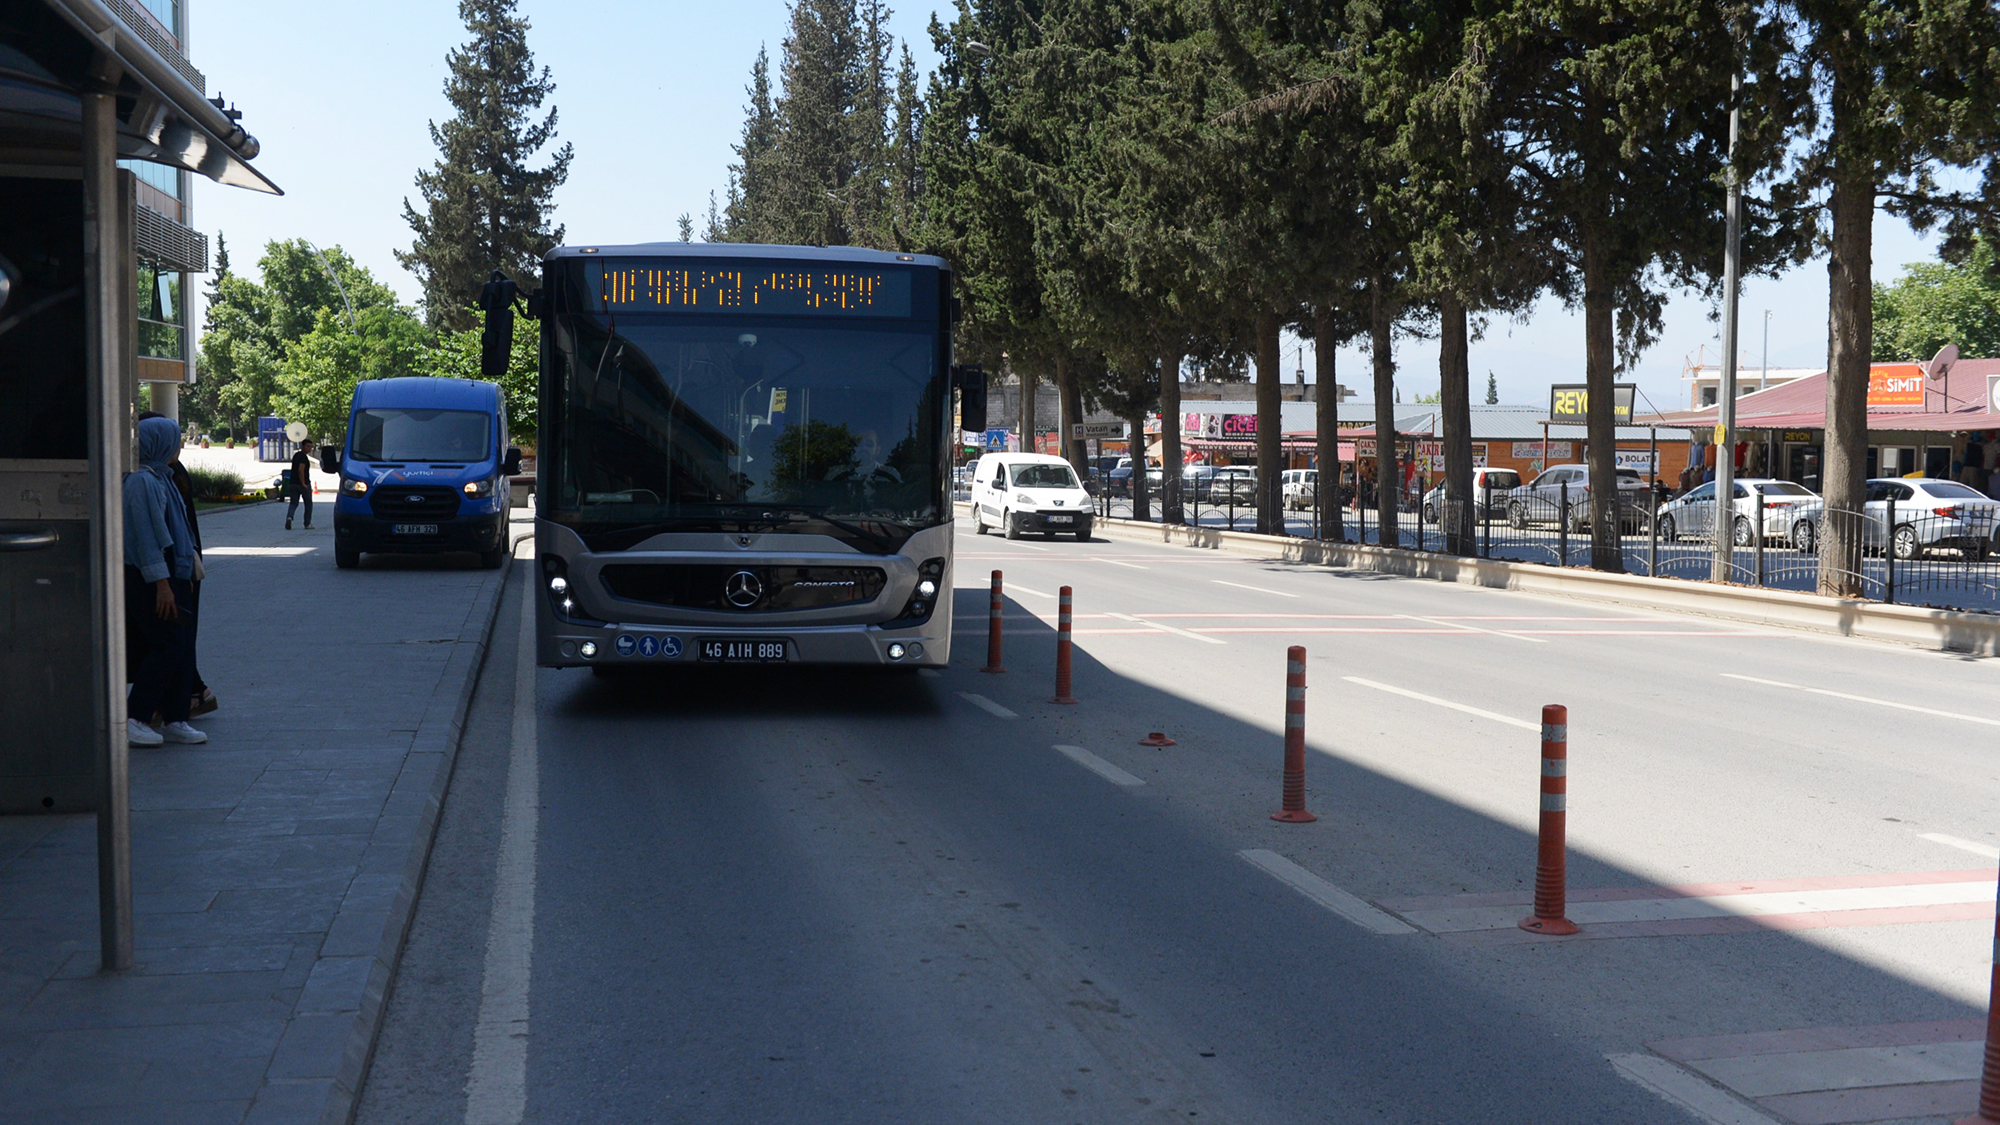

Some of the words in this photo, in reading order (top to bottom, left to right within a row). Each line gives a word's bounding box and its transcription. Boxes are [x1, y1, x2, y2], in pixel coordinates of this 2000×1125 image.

[1785, 432, 1810, 441] REYON
[1417, 444, 1439, 457] ÇAKR
[396, 525, 405, 533] 46
[408, 525, 420, 533] AFH
[424, 525, 437, 533] 329
[706, 643, 722, 657] 46
[728, 643, 752, 658] AIH
[759, 643, 783, 658] 889
